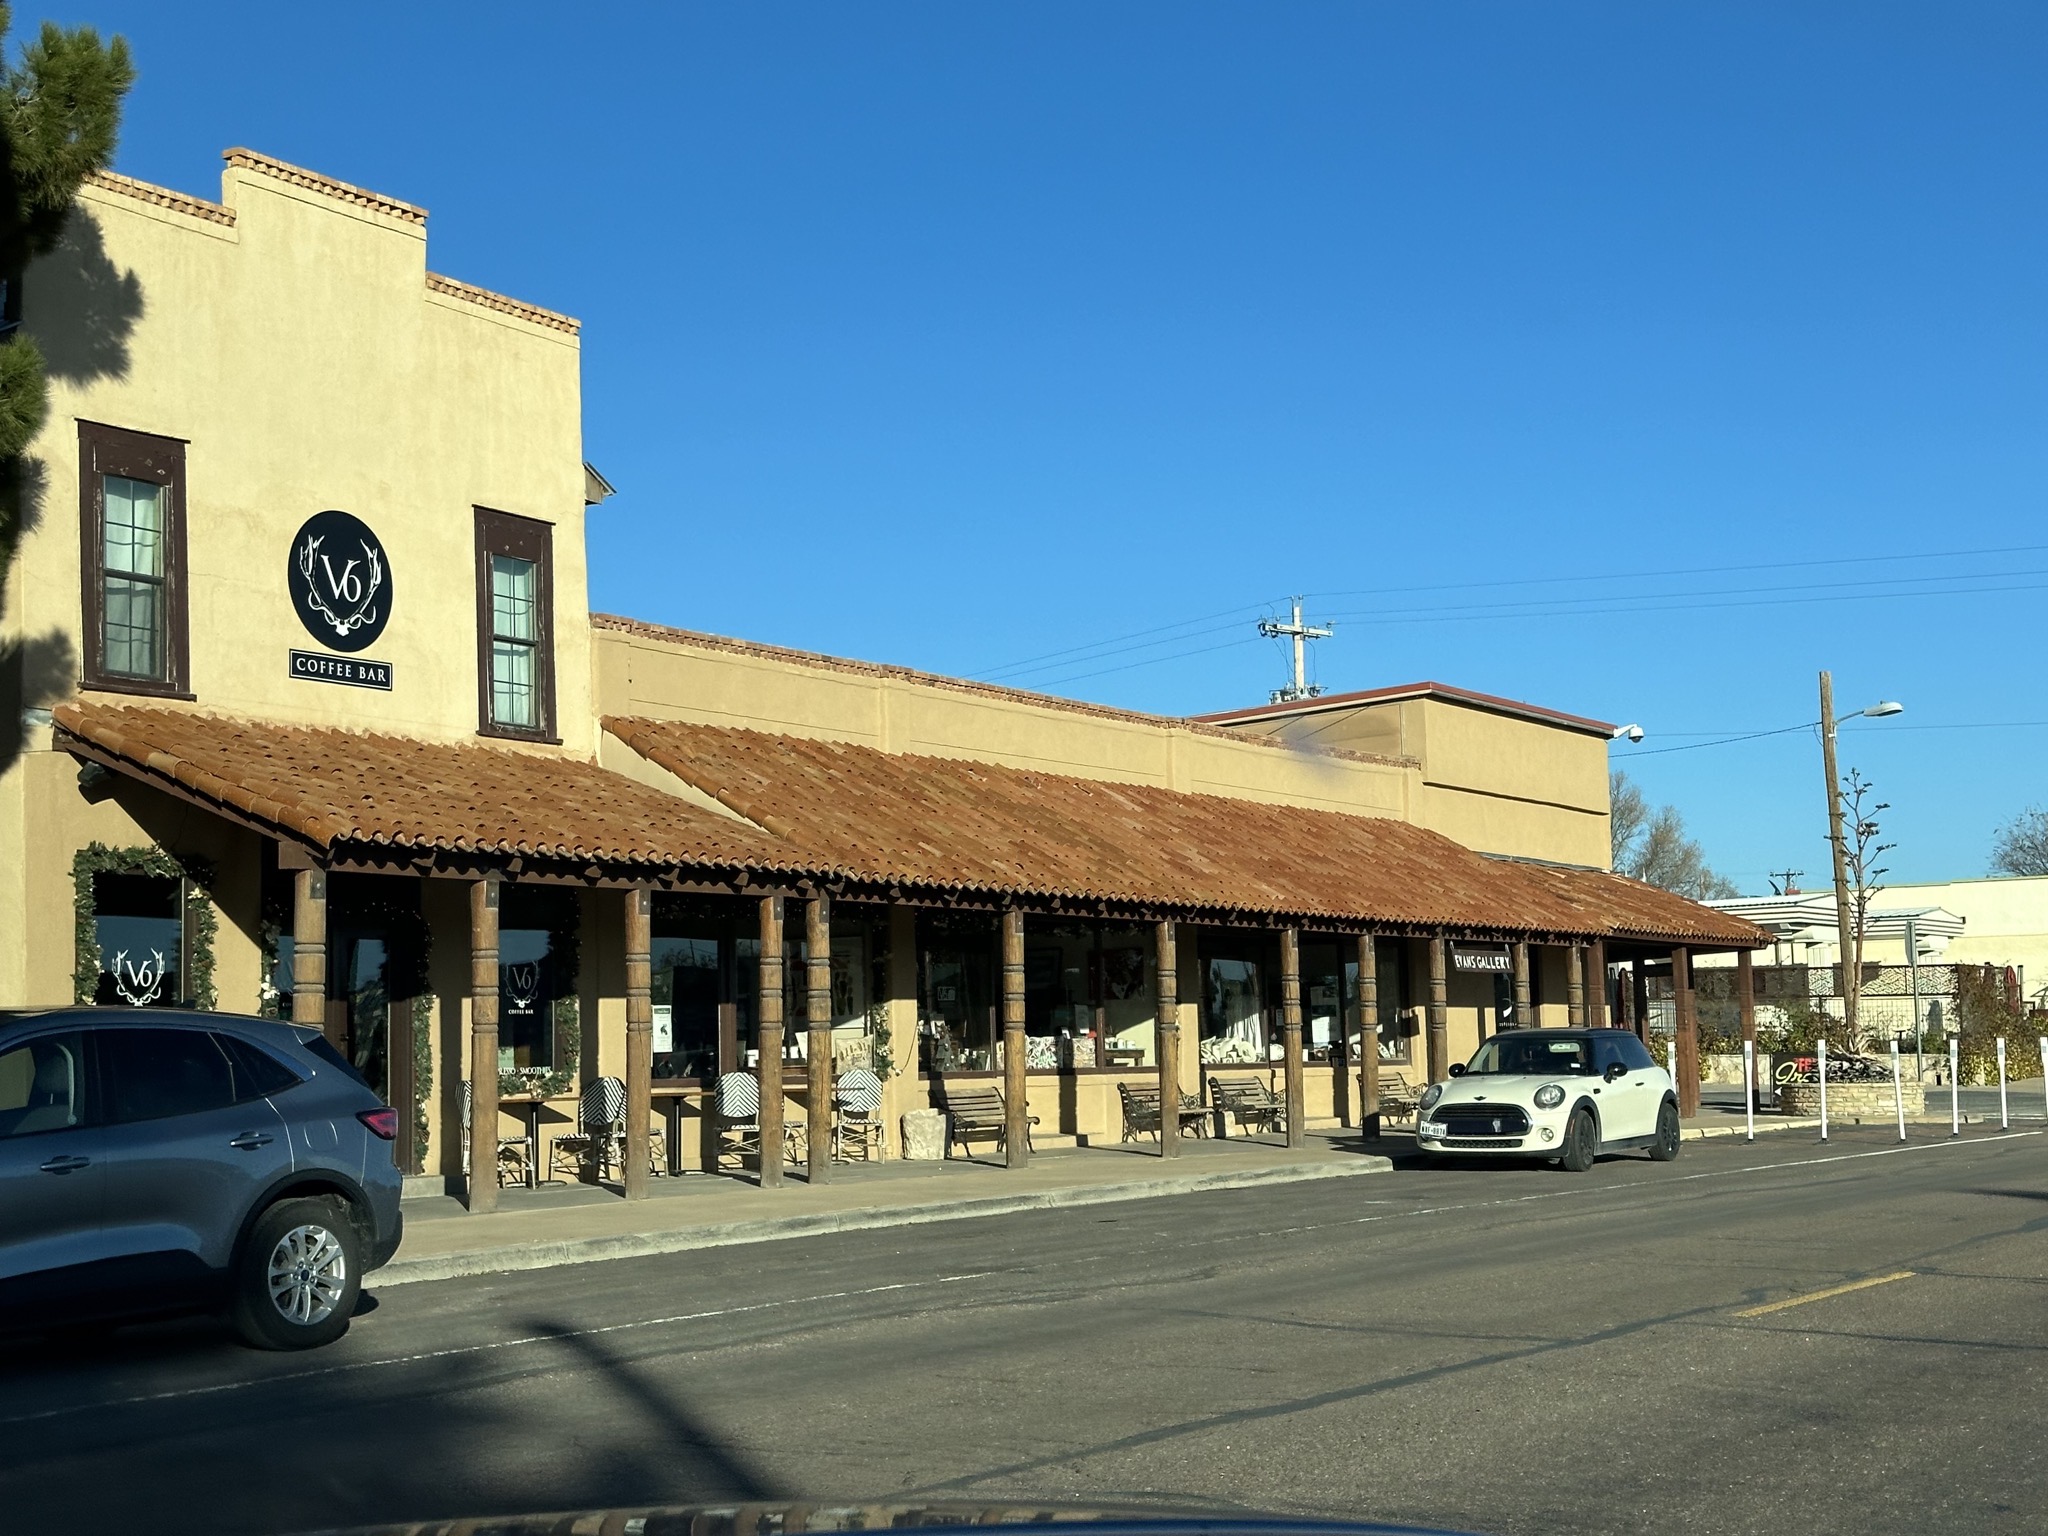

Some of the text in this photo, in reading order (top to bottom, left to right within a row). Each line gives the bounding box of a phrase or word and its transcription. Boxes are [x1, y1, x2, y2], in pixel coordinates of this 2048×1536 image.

[320, 554, 362, 603] V6
[296, 657, 387, 682] COFFEE BAR
[125, 960, 152, 987] V6
[1454, 954, 1510, 970] EVANS GALLERY
[512, 967, 532, 990] V6
